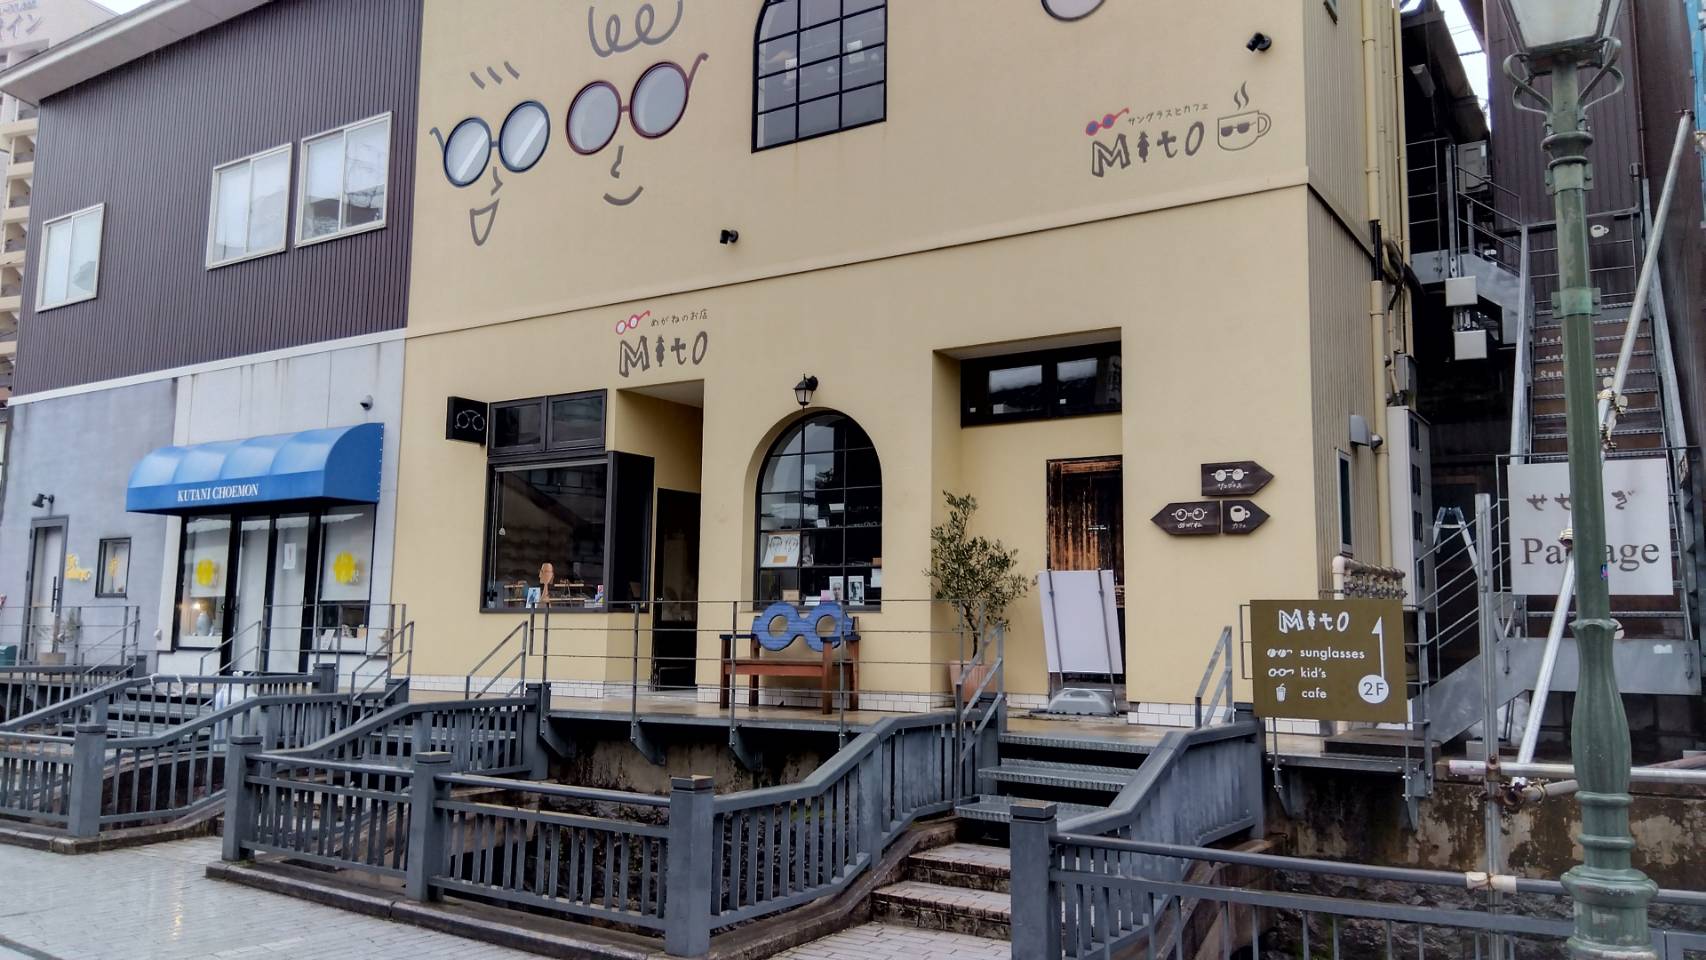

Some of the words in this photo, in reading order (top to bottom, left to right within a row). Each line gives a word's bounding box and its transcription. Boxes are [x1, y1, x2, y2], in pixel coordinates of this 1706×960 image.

[1127, 103, 1209, 126] サングラスとカフェ
[651, 308, 708, 327] めがねのお店
[177, 487, 211, 502] KUTANI
[212, 484, 259, 499] CHOEMON
[1526, 489, 1636, 511] せせぎ
[1520, 537, 1660, 572] Paage
[1300, 646, 1365, 661] sunglasses
[1300, 667, 1327, 678] kid's
[1301, 687, 1328, 699] cafe
[1364, 681, 1384, 696] 2F
